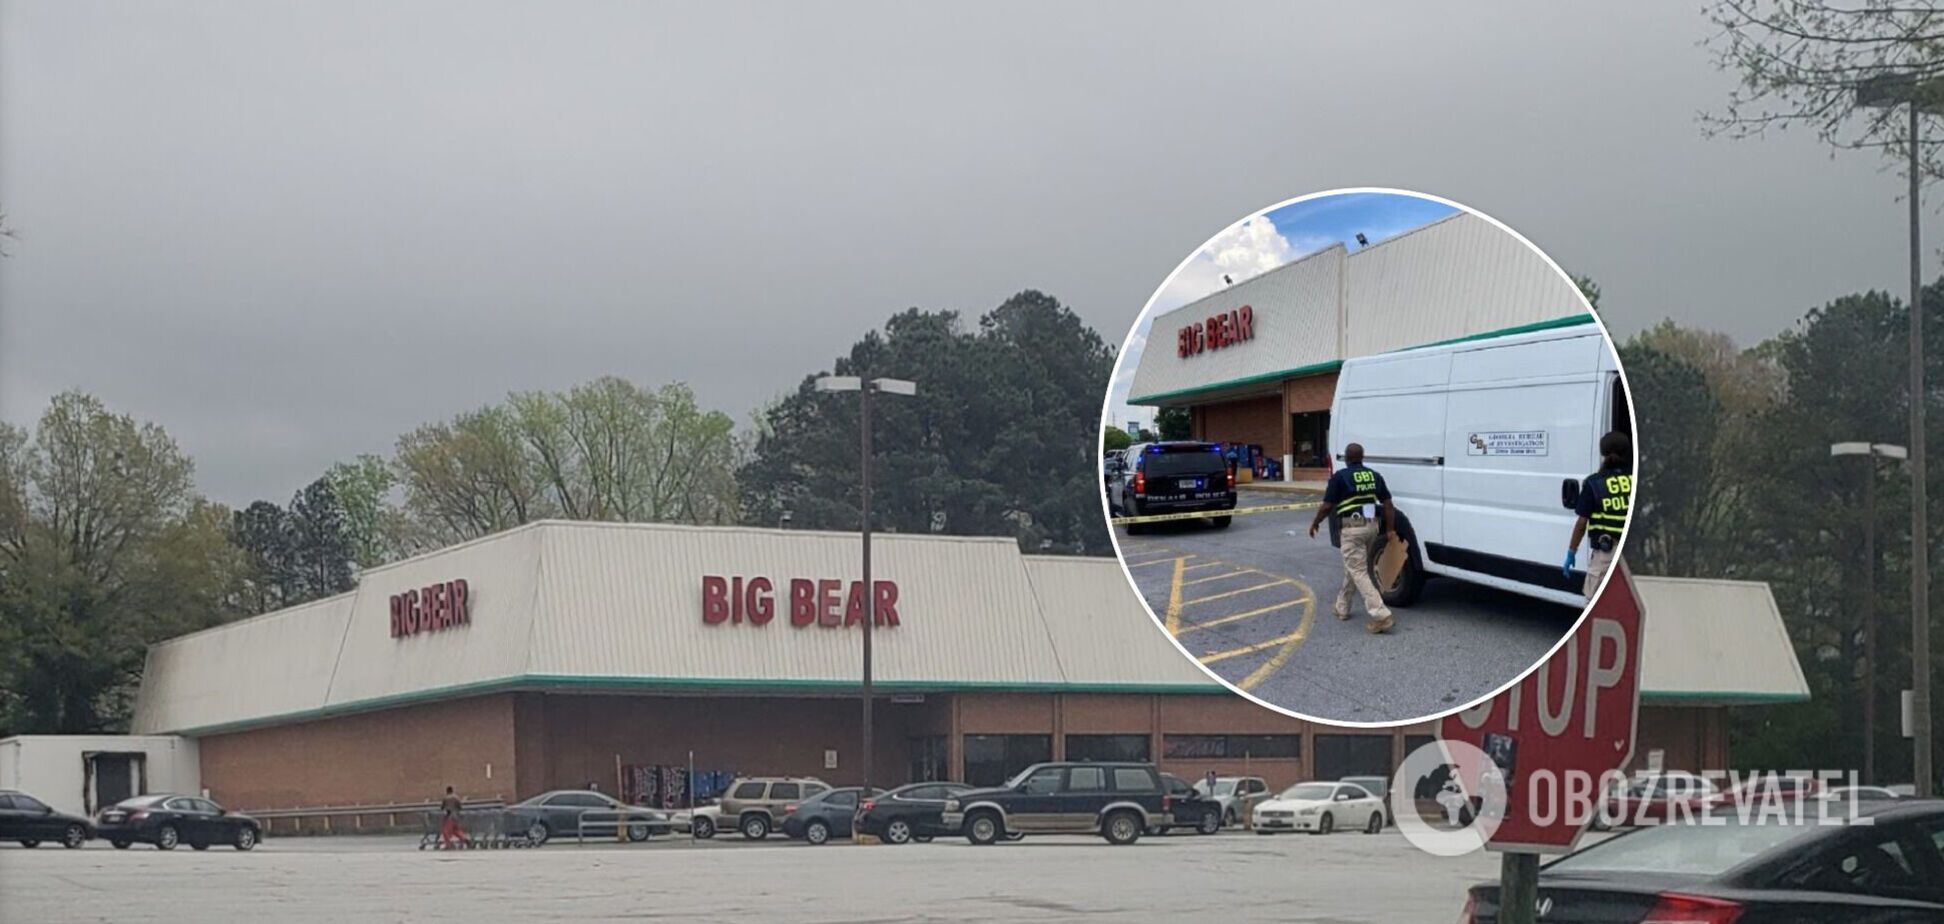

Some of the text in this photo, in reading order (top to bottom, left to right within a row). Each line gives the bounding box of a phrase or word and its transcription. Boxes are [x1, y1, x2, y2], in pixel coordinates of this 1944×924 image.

[1177, 305, 1254, 359] BIG BEAR
[1353, 471, 1375, 482] GBI
[1606, 475, 1633, 494] GB
[1602, 496, 1630, 511] POL
[390, 579, 470, 638] BIG BEAR
[702, 575, 901, 628] BIG BEAR
